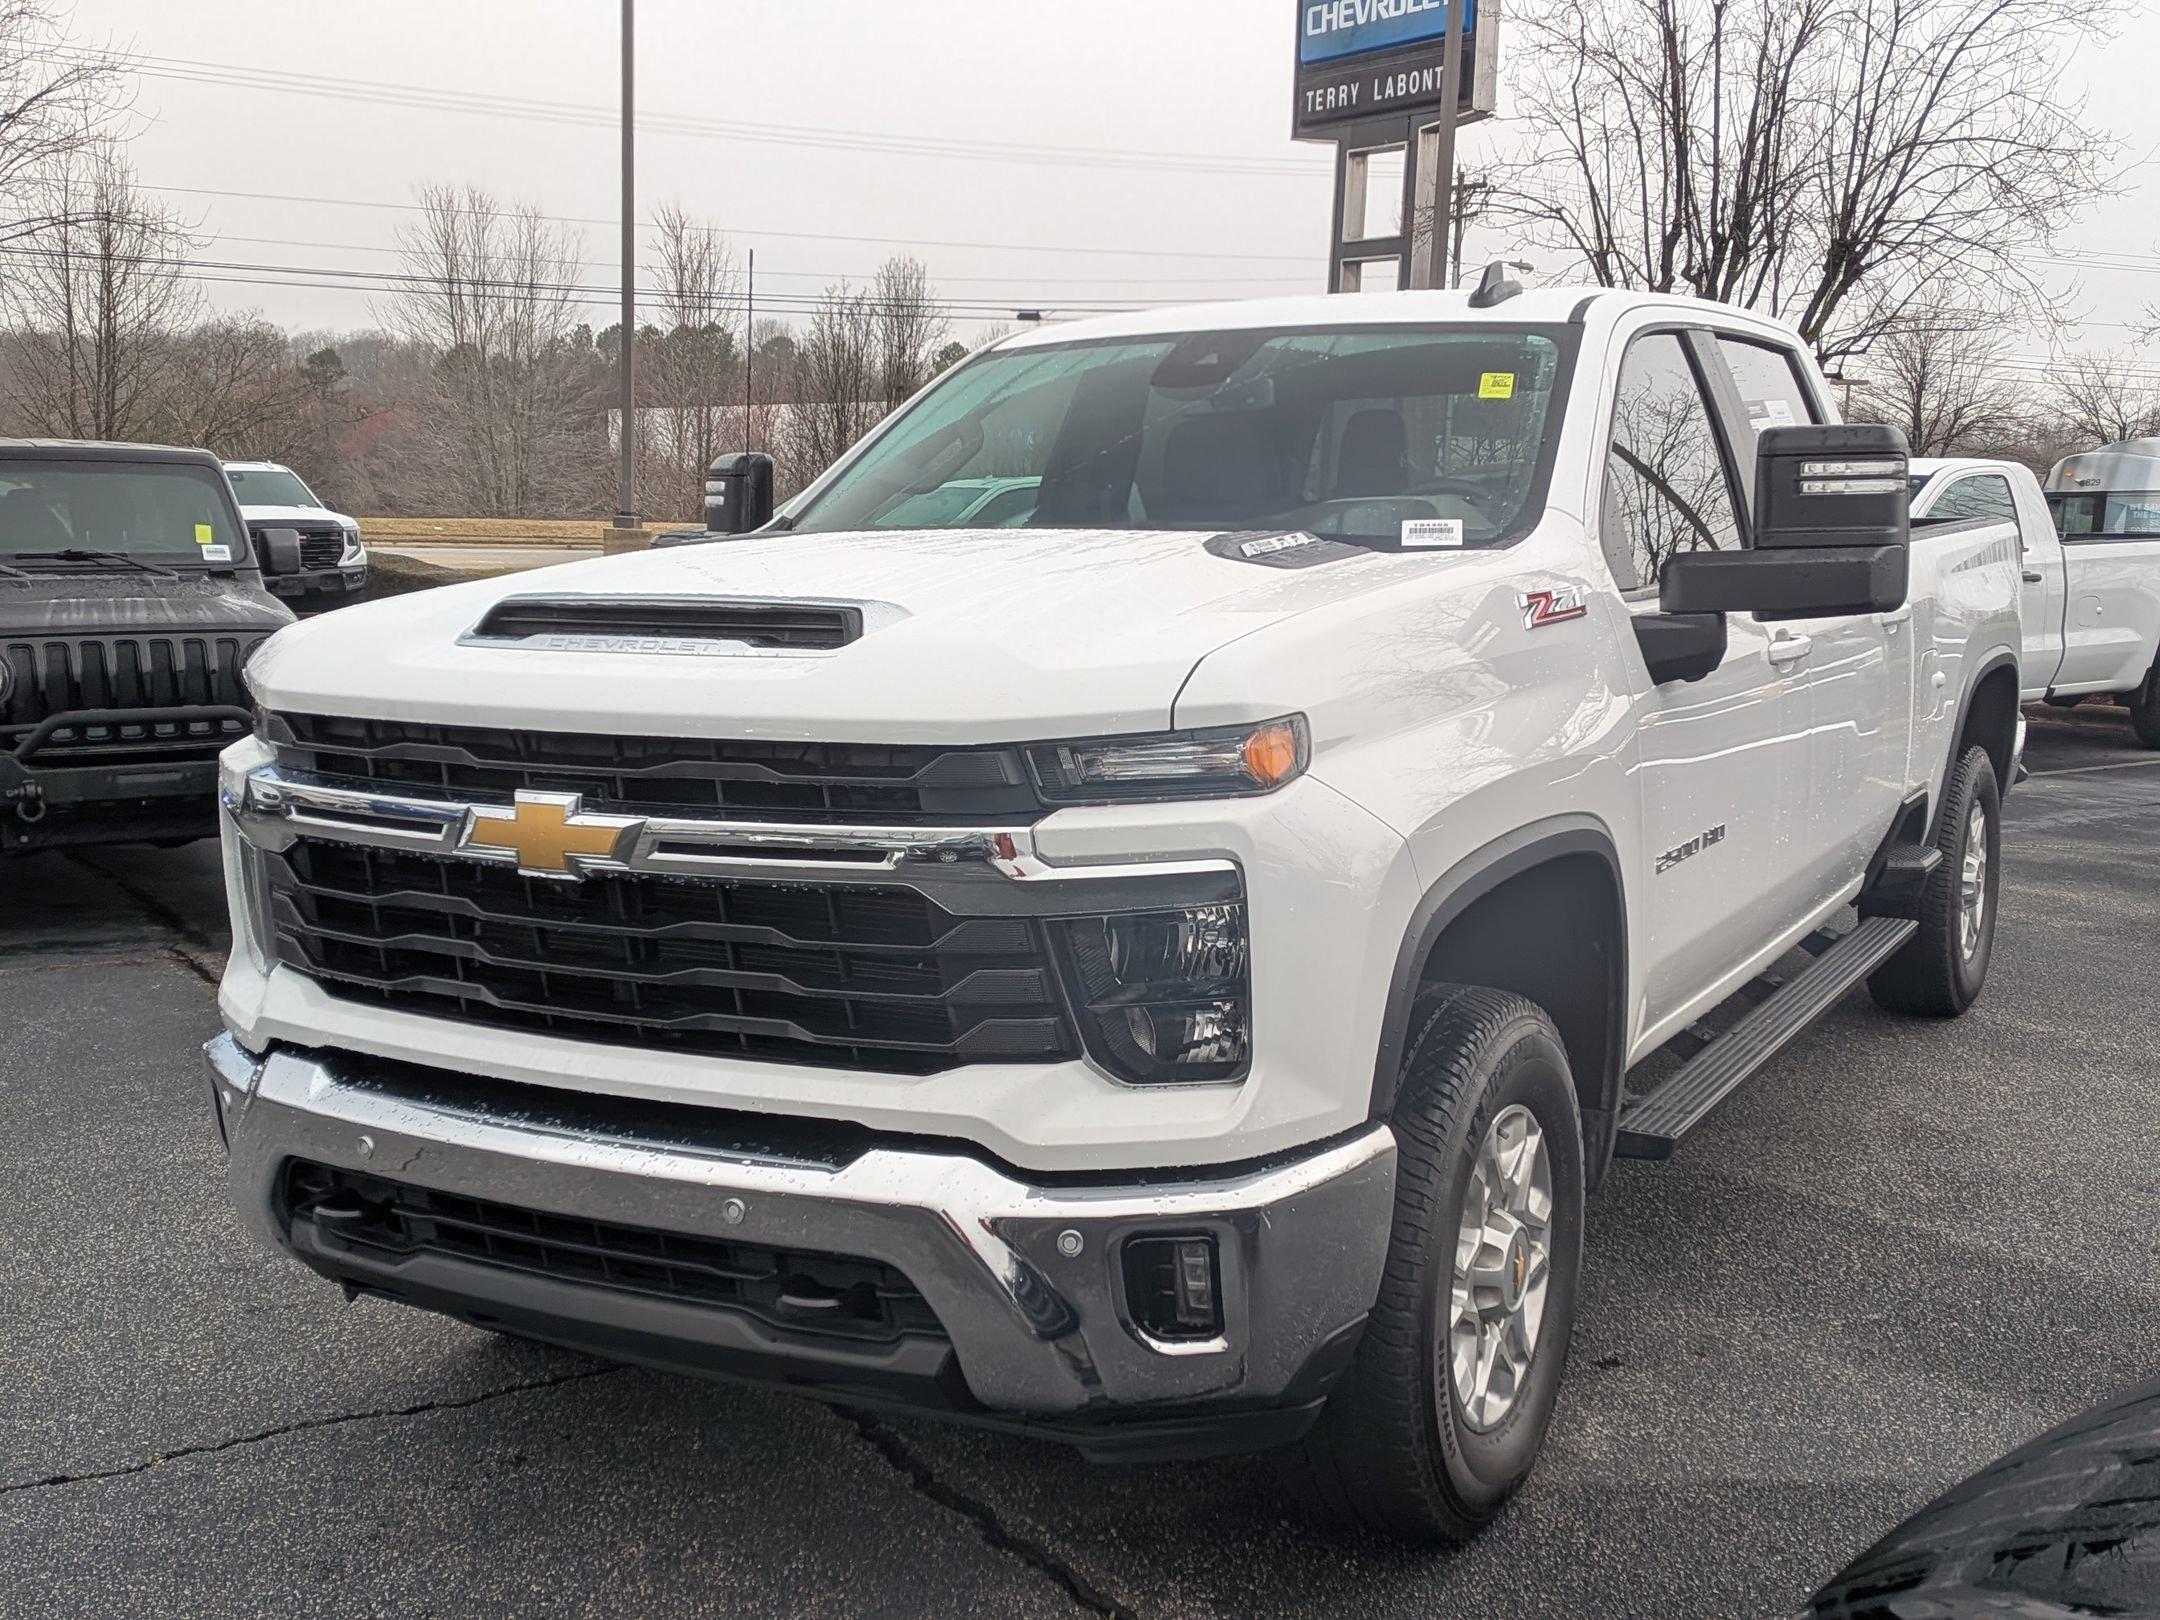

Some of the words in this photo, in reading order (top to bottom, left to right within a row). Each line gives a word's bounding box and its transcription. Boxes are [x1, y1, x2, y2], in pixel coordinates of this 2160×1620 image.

[1306, 0, 1449, 36] CHEVRO
[1306, 83, 1360, 112] TERRY
[1373, 66, 1444, 100] LABONT
[1517, 586, 1588, 630] Z71
[549, 637, 720, 652] CHEVROLET
[1655, 836, 1700, 875] 2500
[1702, 823, 1726, 850] HD
